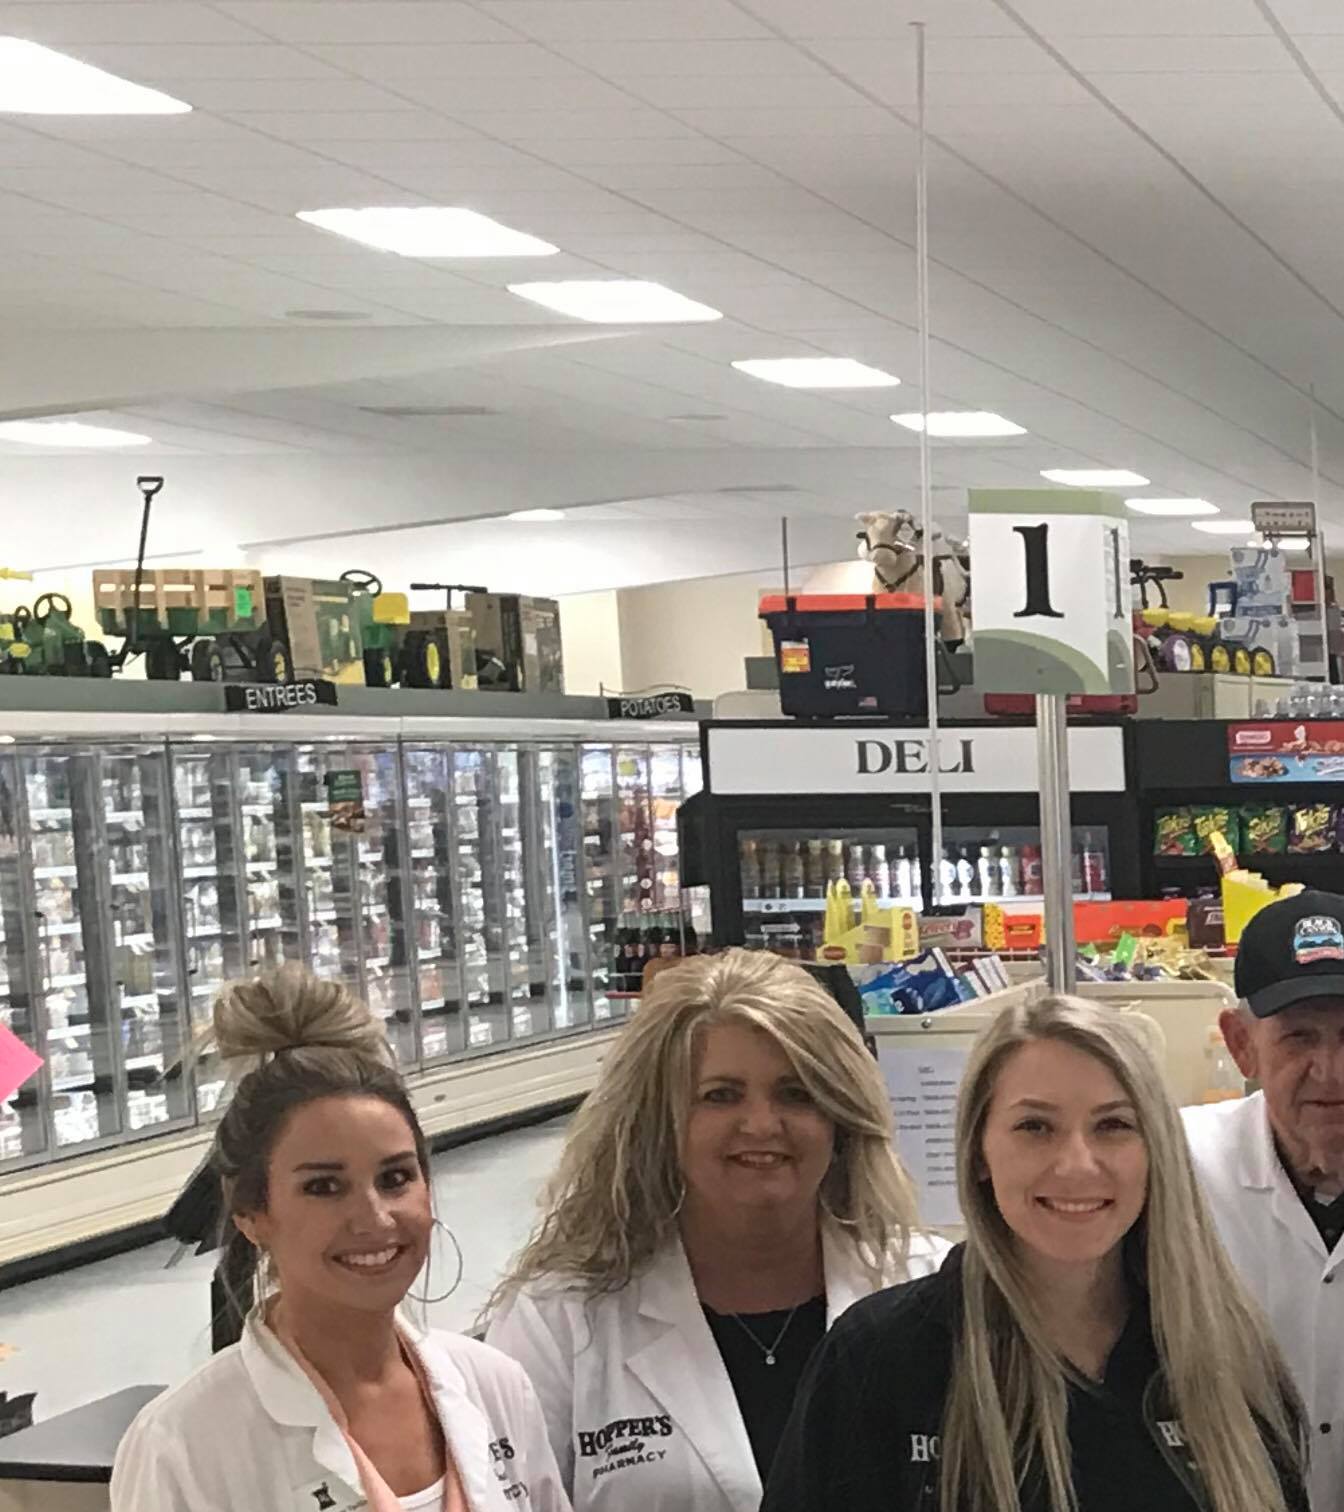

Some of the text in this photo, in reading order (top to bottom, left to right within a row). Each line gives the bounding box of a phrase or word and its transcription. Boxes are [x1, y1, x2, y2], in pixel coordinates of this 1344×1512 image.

[1013, 522, 1065, 618] 1
[244, 682, 318, 710] ENTREES
[620, 695, 681, 717] POTATOES
[578, 1415, 673, 1457] HOPPER'S
[592, 1450, 667, 1480] PHARMACY
